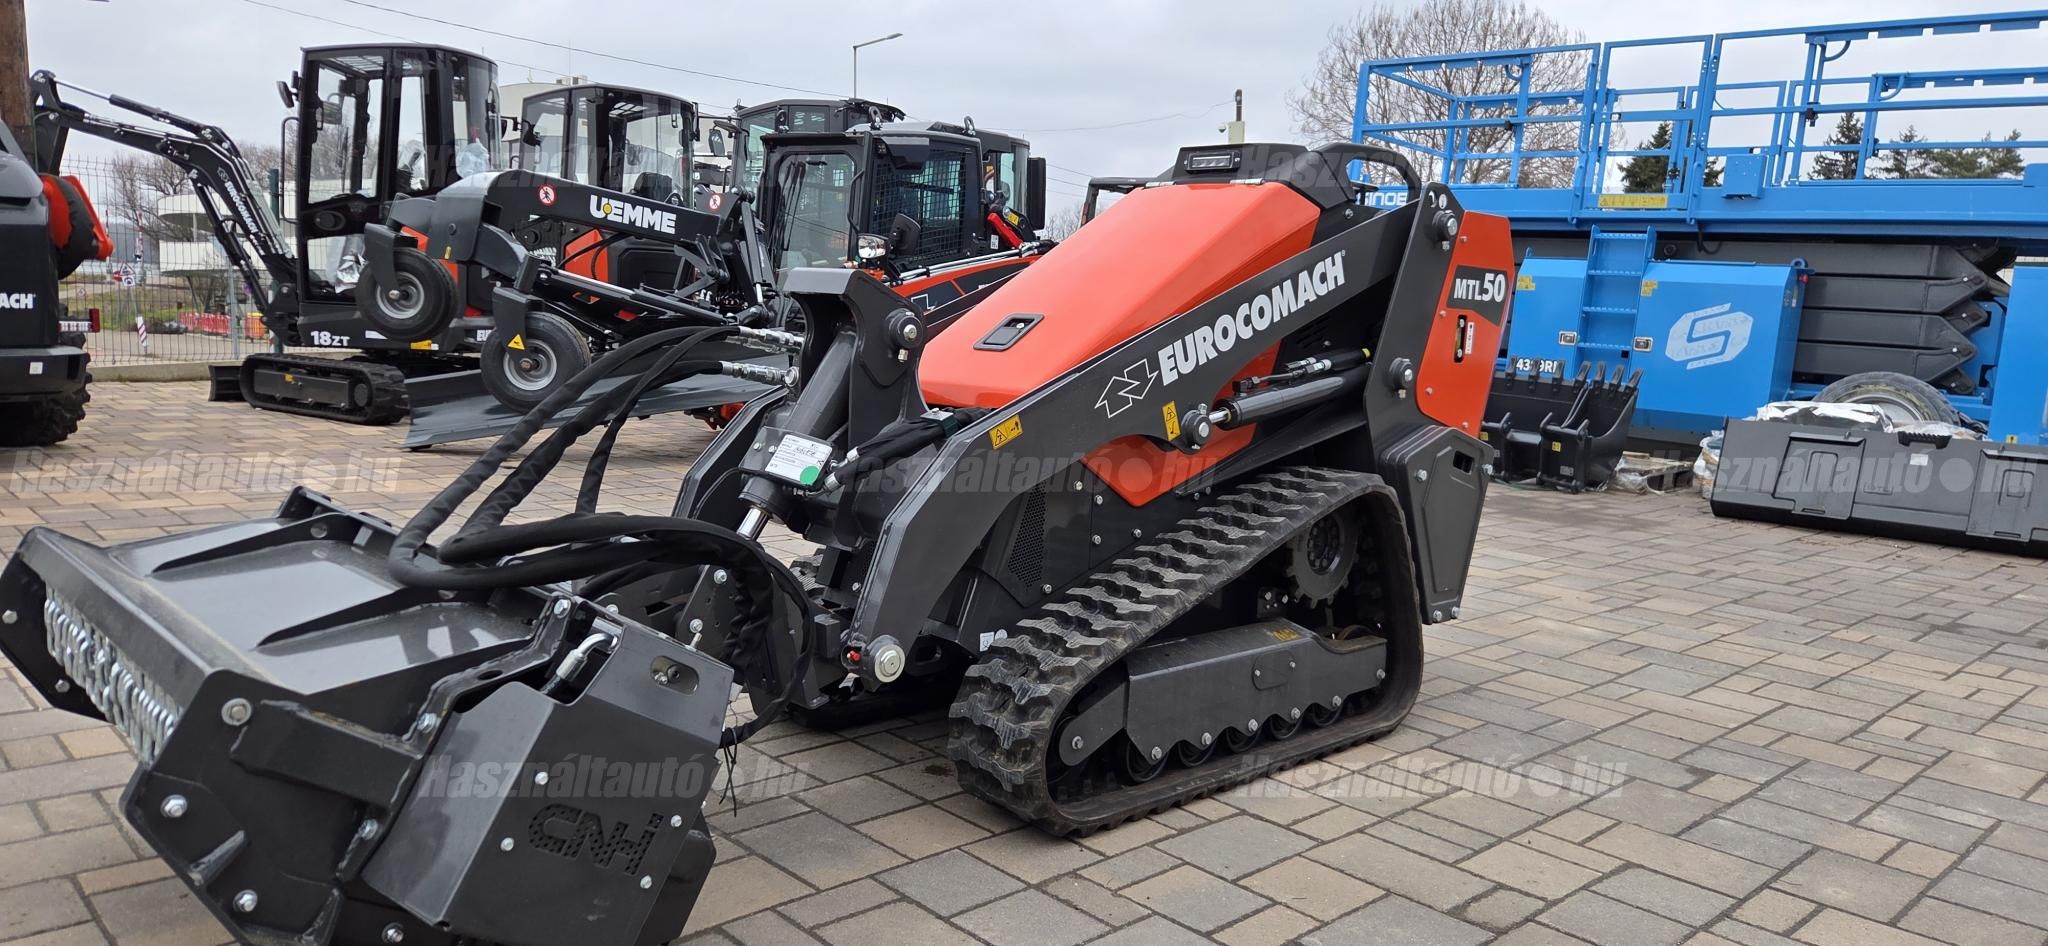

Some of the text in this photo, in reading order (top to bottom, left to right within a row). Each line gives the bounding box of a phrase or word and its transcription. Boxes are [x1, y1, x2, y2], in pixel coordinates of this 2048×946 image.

[224, 181, 259, 234] EUROCOMACH
[1453, 272, 1506, 303] MTL50
[310, 330, 350, 347] 18ZT
[1158, 251, 1346, 386] EUROCOMACH
